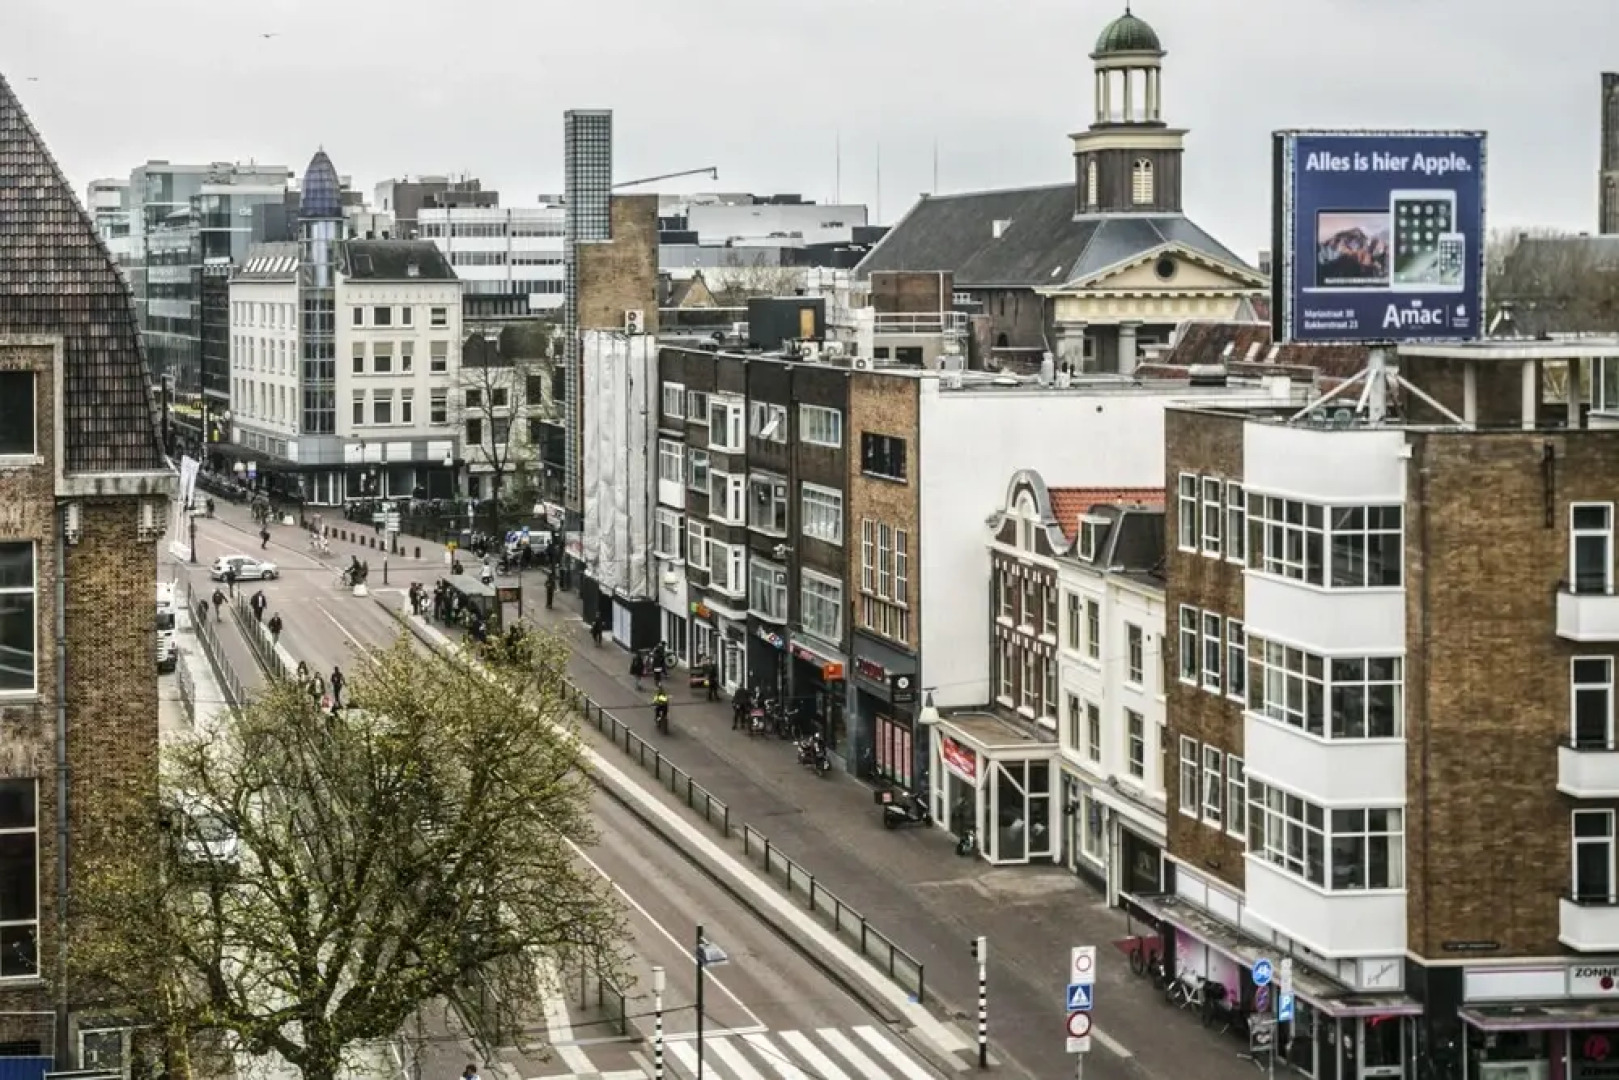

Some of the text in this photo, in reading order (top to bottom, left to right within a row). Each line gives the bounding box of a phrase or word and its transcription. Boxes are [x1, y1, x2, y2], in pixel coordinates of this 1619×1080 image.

[1306, 151, 1471, 175] Alles is hier Apple.
[1382, 303, 1442, 329] Amac
